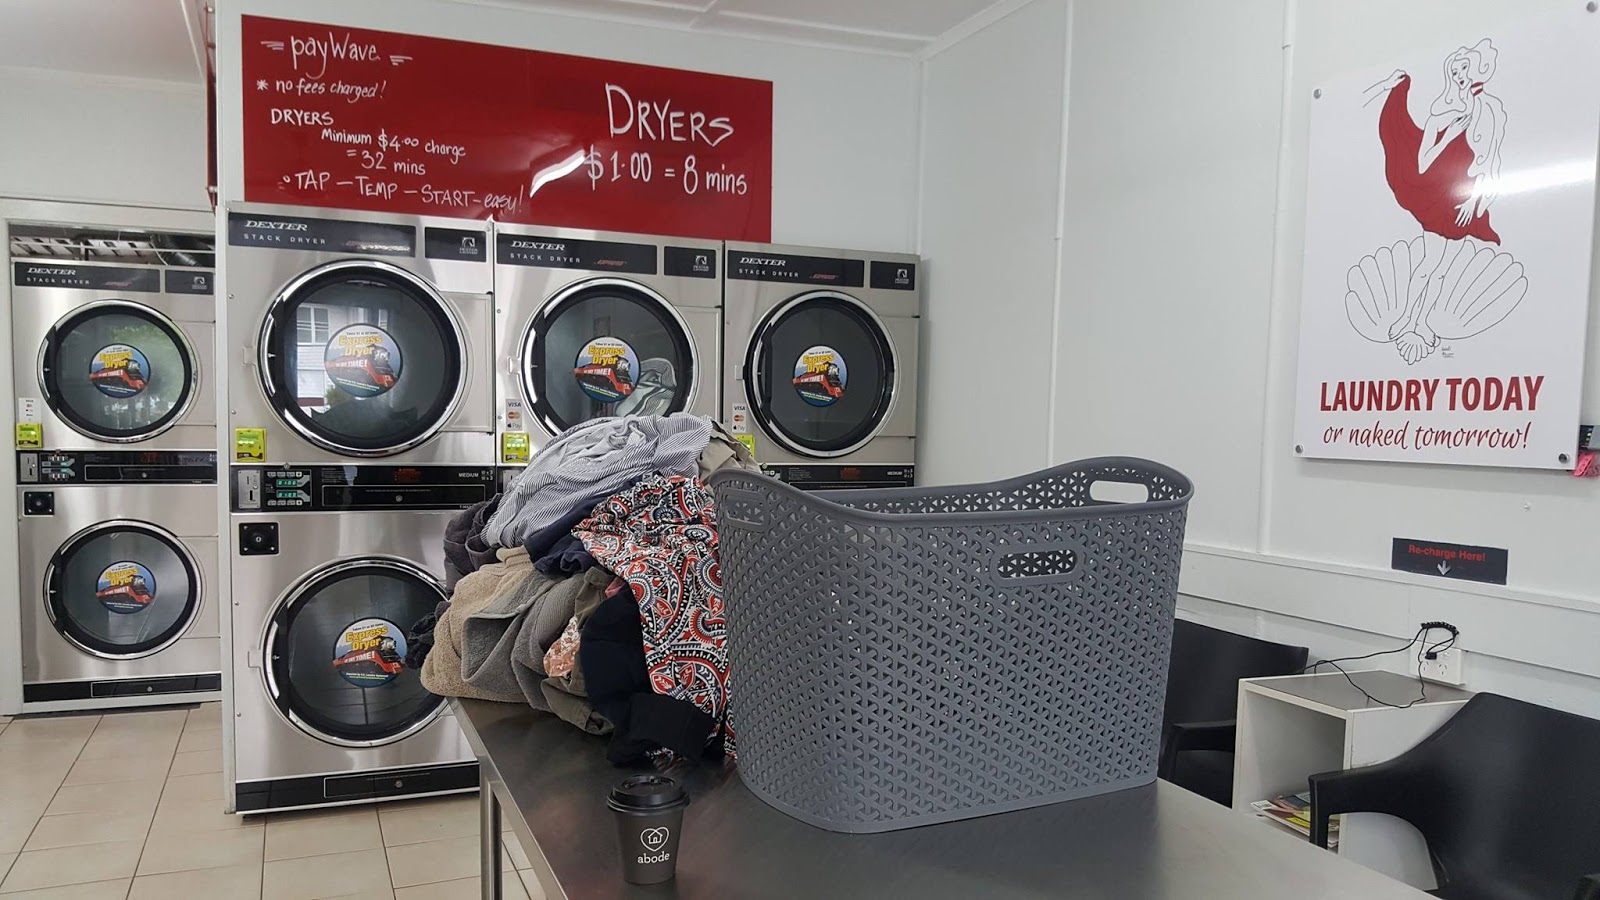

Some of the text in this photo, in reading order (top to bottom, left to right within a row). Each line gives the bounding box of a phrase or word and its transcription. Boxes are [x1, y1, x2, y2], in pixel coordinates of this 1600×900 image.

[291, 32, 381, 79] payWave
[275, 78, 387, 103] no fees charged!
[271, 108, 334, 126] DRYERS
[605, 82, 734, 147] DRYERS
[321, 128, 372, 145] Minimum
[425, 140, 466, 164] charge
[361, 150, 387, 170] 32
[393, 158, 426, 176] mins
[683, 154, 699, 195] 8
[706, 164, 748, 195] mins
[294, 169, 331, 190] TAP
[355, 175, 398, 200] TEMP
[244, 220, 308, 231] DEXTER
[243, 233, 326, 245] STACK DRYER
[510, 240, 565, 251] DEXTER
[510, 252, 542, 260] STACK
[739, 257, 786, 266] DEXTER
[27, 267, 76, 276] DEXTER
[739, 268, 766, 276] STACK
[339, 335, 383, 346] Express
[344, 346, 375, 358] Dryer
[588, 345, 625, 356] Express
[592, 355, 618, 367] Dryer
[802, 354, 835, 364] Express
[806, 363, 829, 373] Dryer
[1320, 375, 1545, 412] LAUNDRY TODAY
[1323, 420, 1532, 450] or naked tomorrow!
[1408, 544, 1486, 562] Re-charge Here!
[345, 626, 389, 642] Express
[351, 637, 382, 651] Dryer
[637, 850, 670, 864] abode
